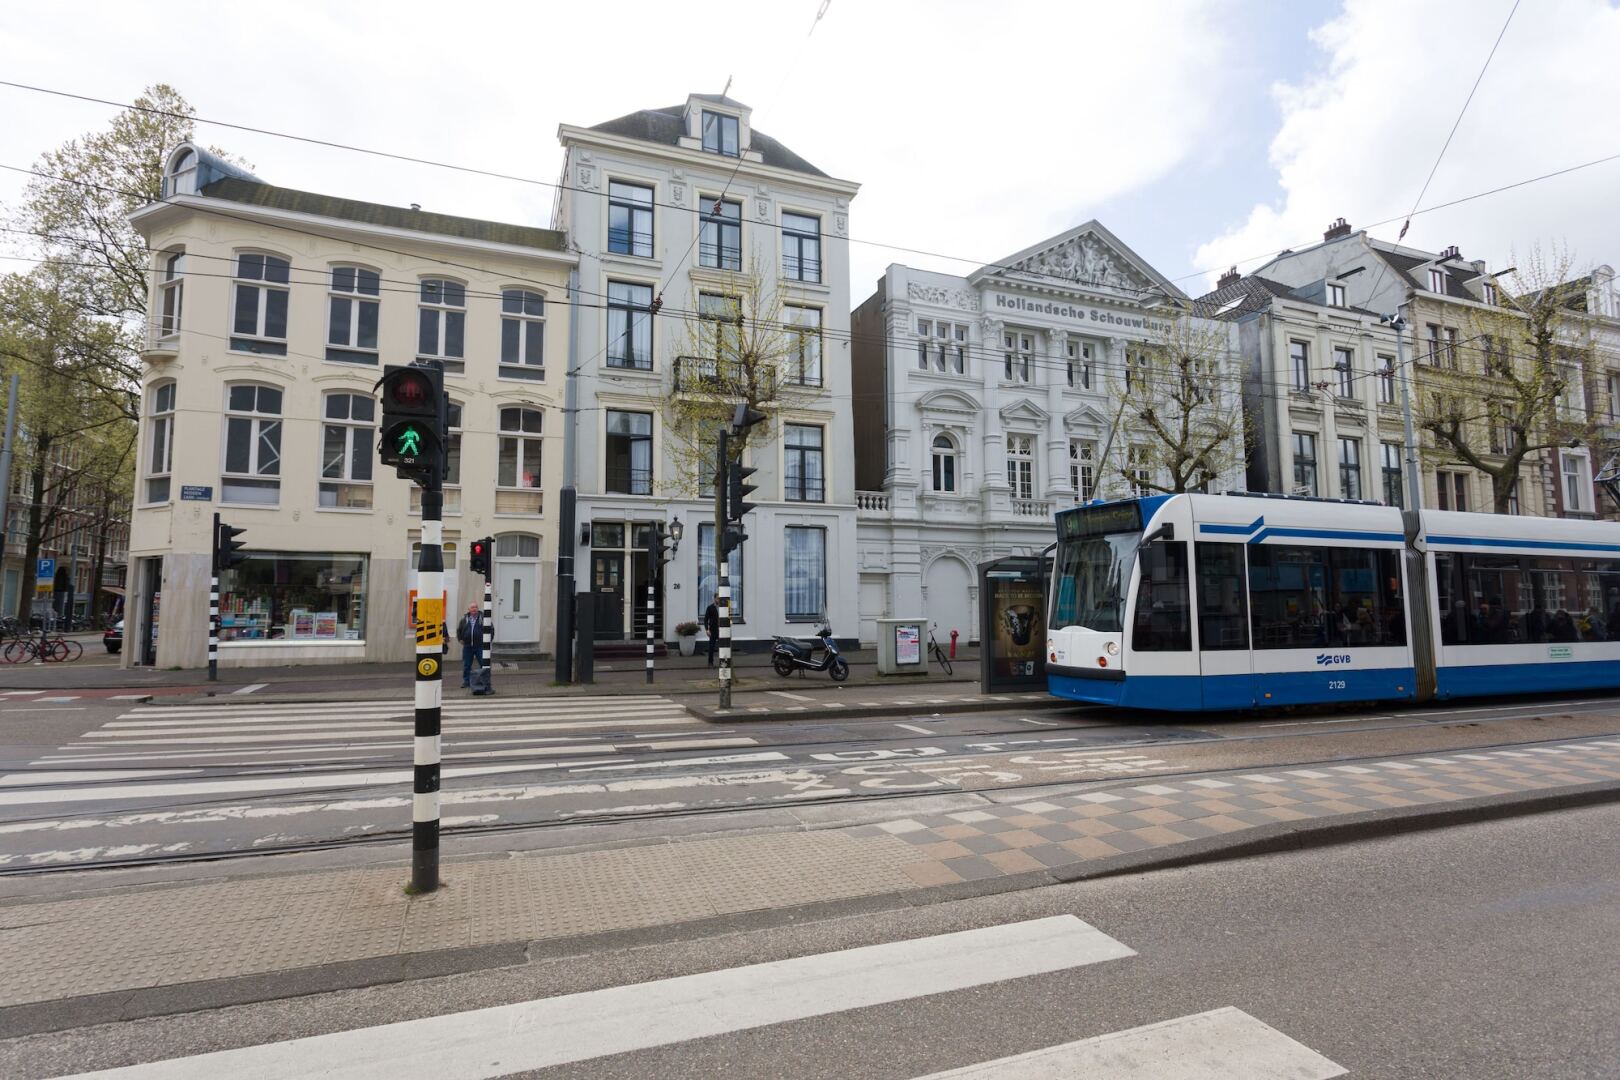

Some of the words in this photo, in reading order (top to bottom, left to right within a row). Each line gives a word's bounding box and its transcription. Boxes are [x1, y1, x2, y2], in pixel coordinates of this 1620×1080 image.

[996, 294, 1085, 320] Hollandsche
[1090, 310, 1172, 334] Schouwburg
[41, 560, 50, 570] P
[1333, 655, 1351, 664] GVB
[1328, 680, 1346, 689] 2129
